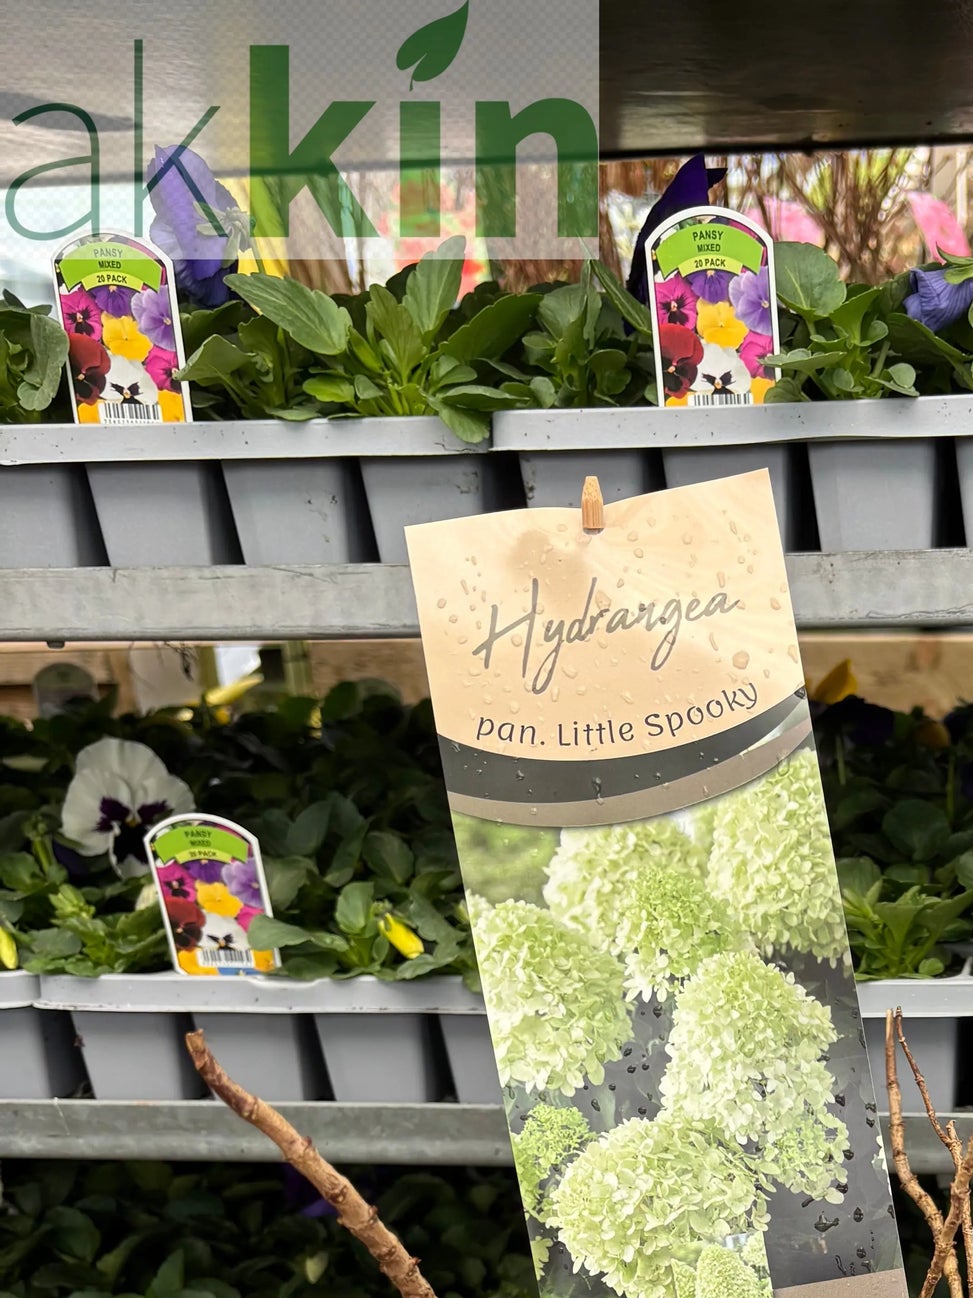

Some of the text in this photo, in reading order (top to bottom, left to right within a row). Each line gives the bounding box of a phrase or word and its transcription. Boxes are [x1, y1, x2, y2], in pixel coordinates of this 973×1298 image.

[692, 230, 724, 241] PANSY
[696, 243, 721, 252] MIXED
[93, 248, 123, 258] PANSY
[98, 260, 122, 270] MIXED
[694, 258, 726, 268] 20 PACK
[96, 274, 127, 284] 20 PACK
[472, 577, 740, 695] Hydrangea
[476, 682, 758, 747] pan. Little Spooky
[184, 830, 212, 838] PANSY
